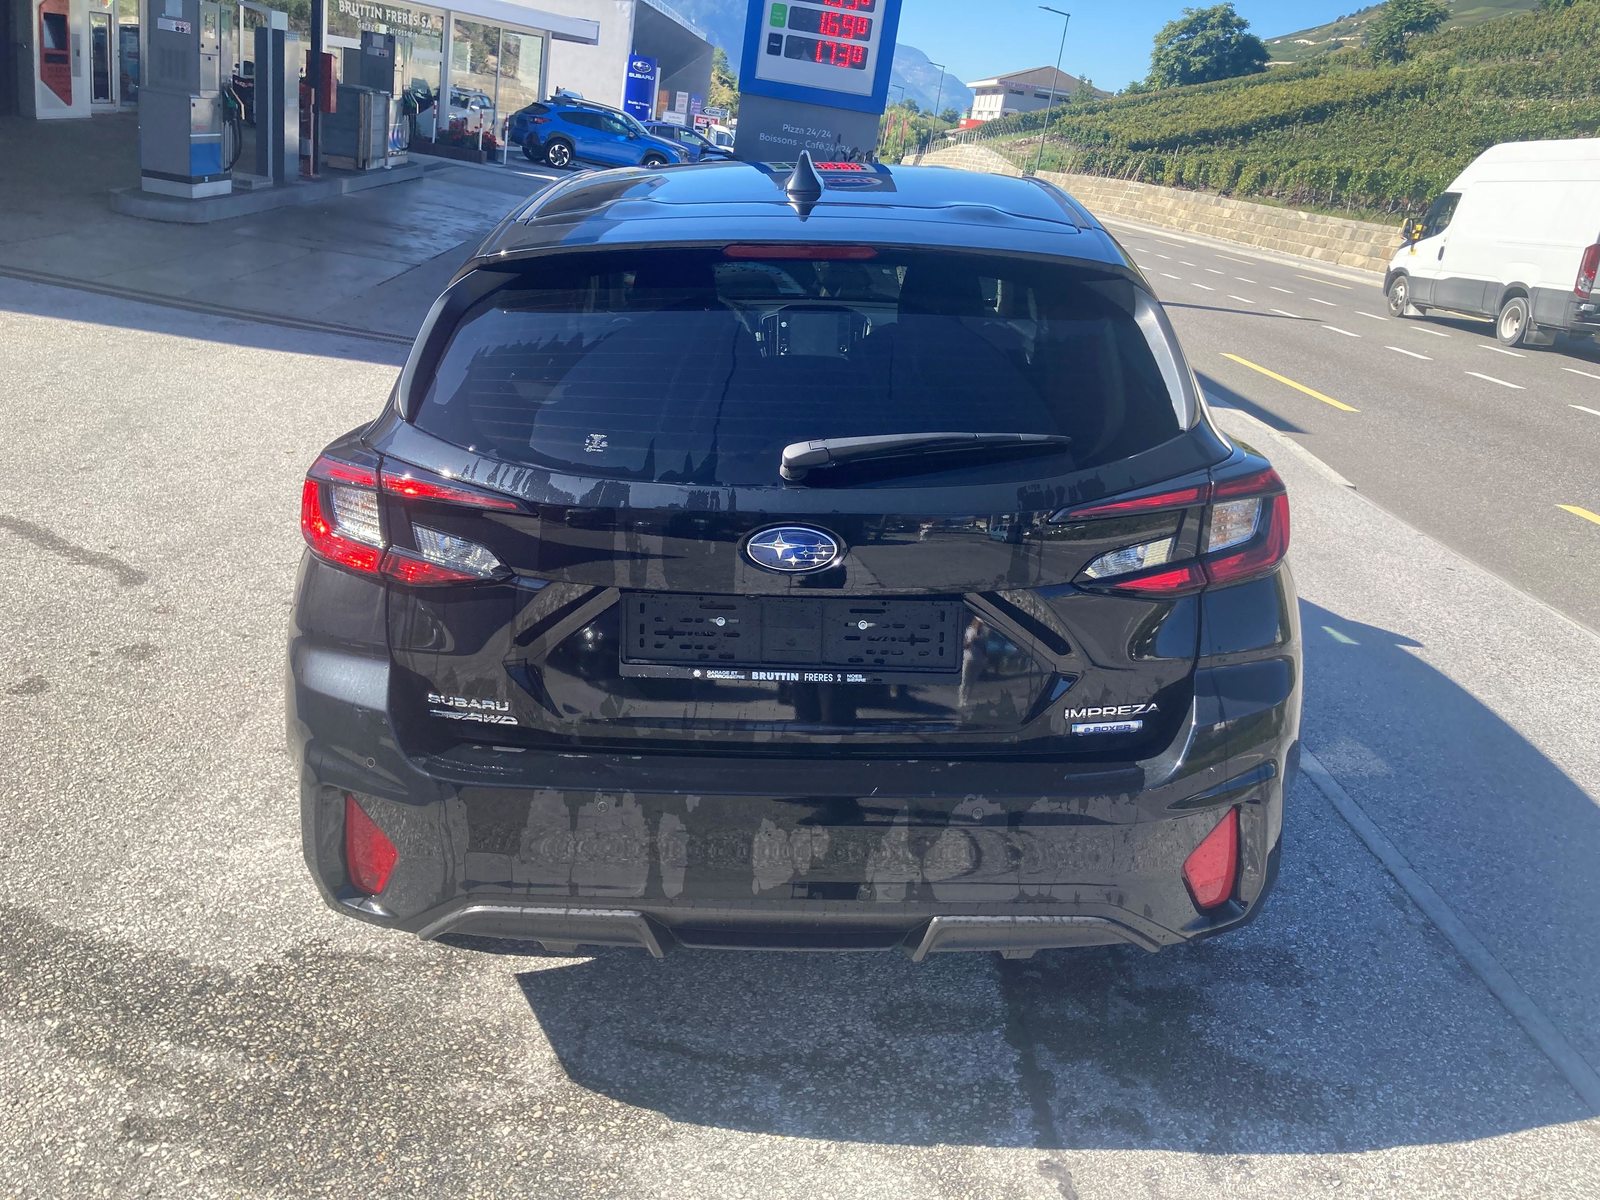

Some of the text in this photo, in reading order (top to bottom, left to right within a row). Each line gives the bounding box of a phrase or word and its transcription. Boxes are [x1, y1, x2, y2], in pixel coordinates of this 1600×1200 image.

[339, 0, 382, 19] BRUTTIN
[421, 15, 432, 29] SA
[628, 72, 654, 80] SUBARU
[782, 123, 832, 138] Pizza 24/24
[759, 132, 798, 146] Boissons
[751, 671, 799, 681] BRUTTIN
[428, 693, 509, 711] SUBARU
[1064, 702, 1160, 719] IMPREZA
[461, 711, 518, 726] AWD
